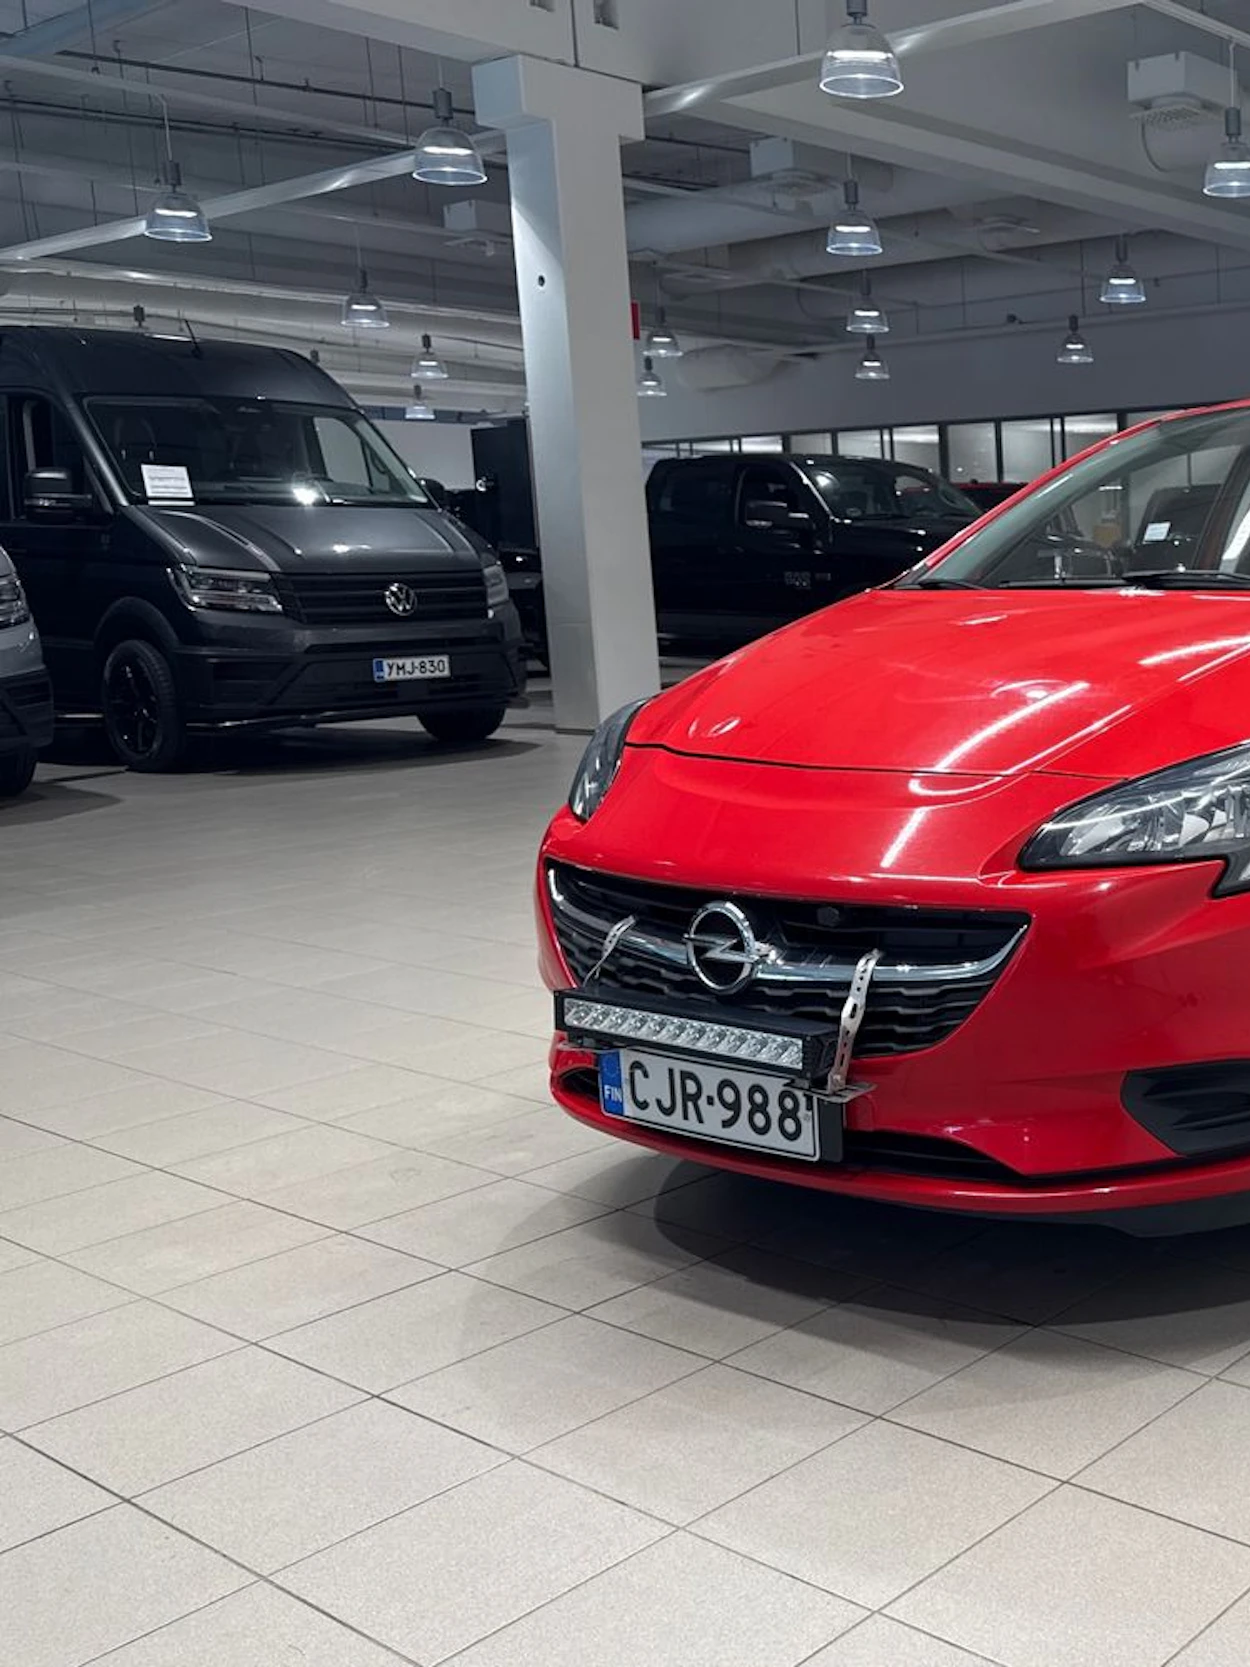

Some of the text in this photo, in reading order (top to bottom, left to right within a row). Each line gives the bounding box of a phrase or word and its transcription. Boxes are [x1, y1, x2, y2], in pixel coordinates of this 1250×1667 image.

[387, 660, 446, 676] YMJ-830
[604, 1060, 802, 1142] FIN CJR-988
